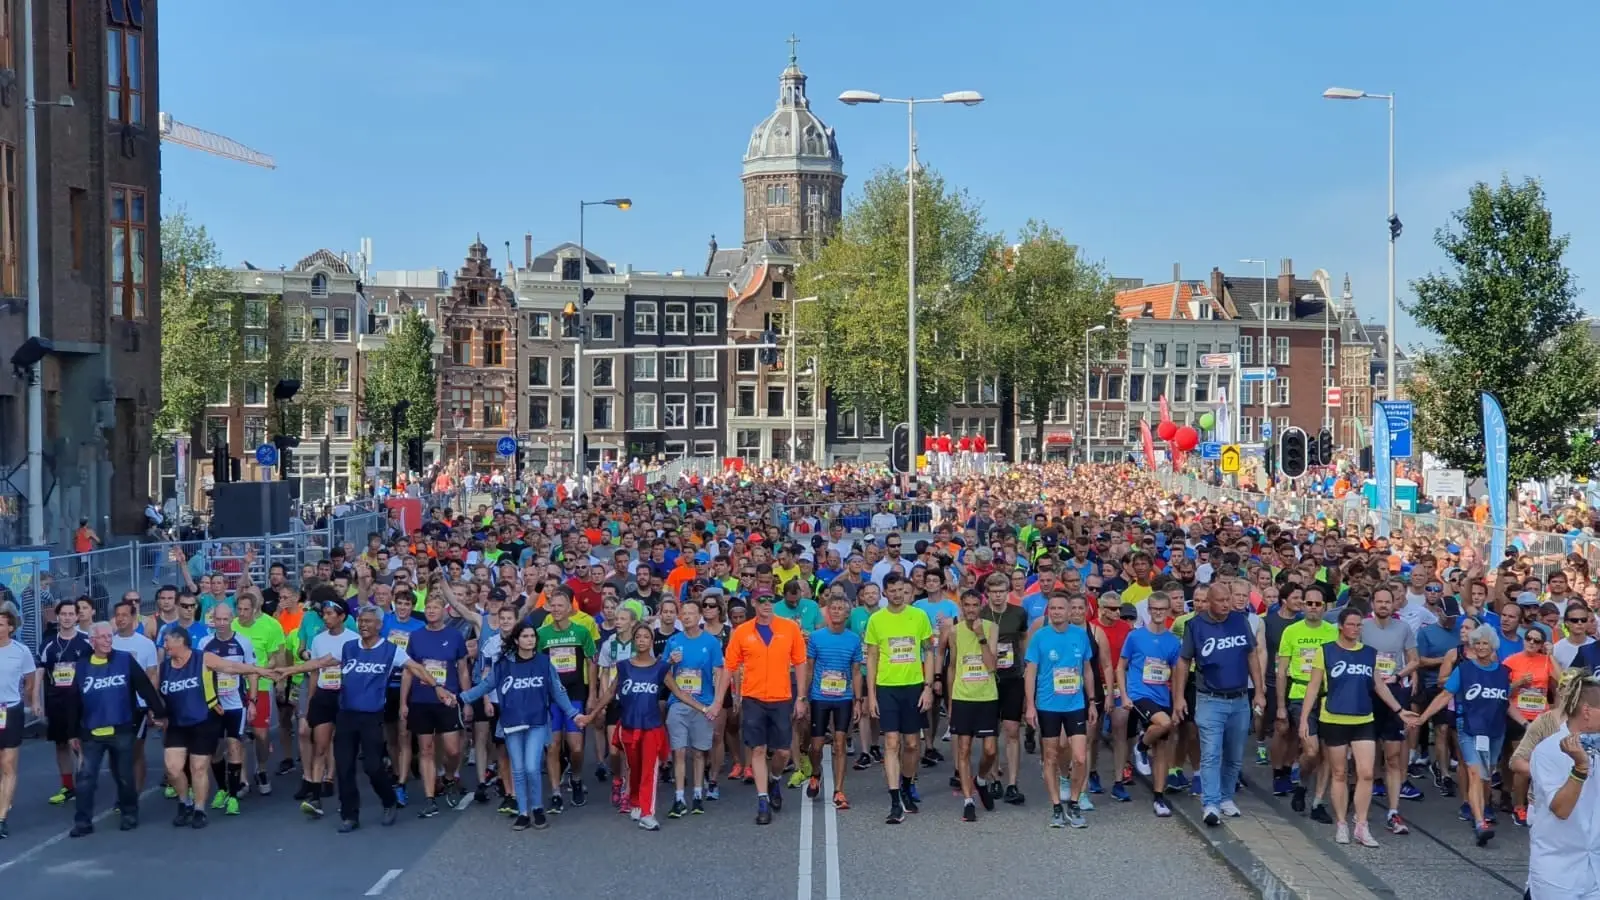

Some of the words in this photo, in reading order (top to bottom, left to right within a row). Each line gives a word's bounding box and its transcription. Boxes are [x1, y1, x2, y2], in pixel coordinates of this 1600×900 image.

[1226, 456, 1234, 467] 7
[1217, 635, 1248, 650] asics
[1297, 637, 1324, 645] CRAFT
[355, 662, 387, 674] asics
[1346, 663, 1373, 677] asic
[93, 674, 126, 690] asics
[168, 676, 199, 693] asics
[513, 676, 544, 689] asics
[1481, 687, 1508, 700] asic
